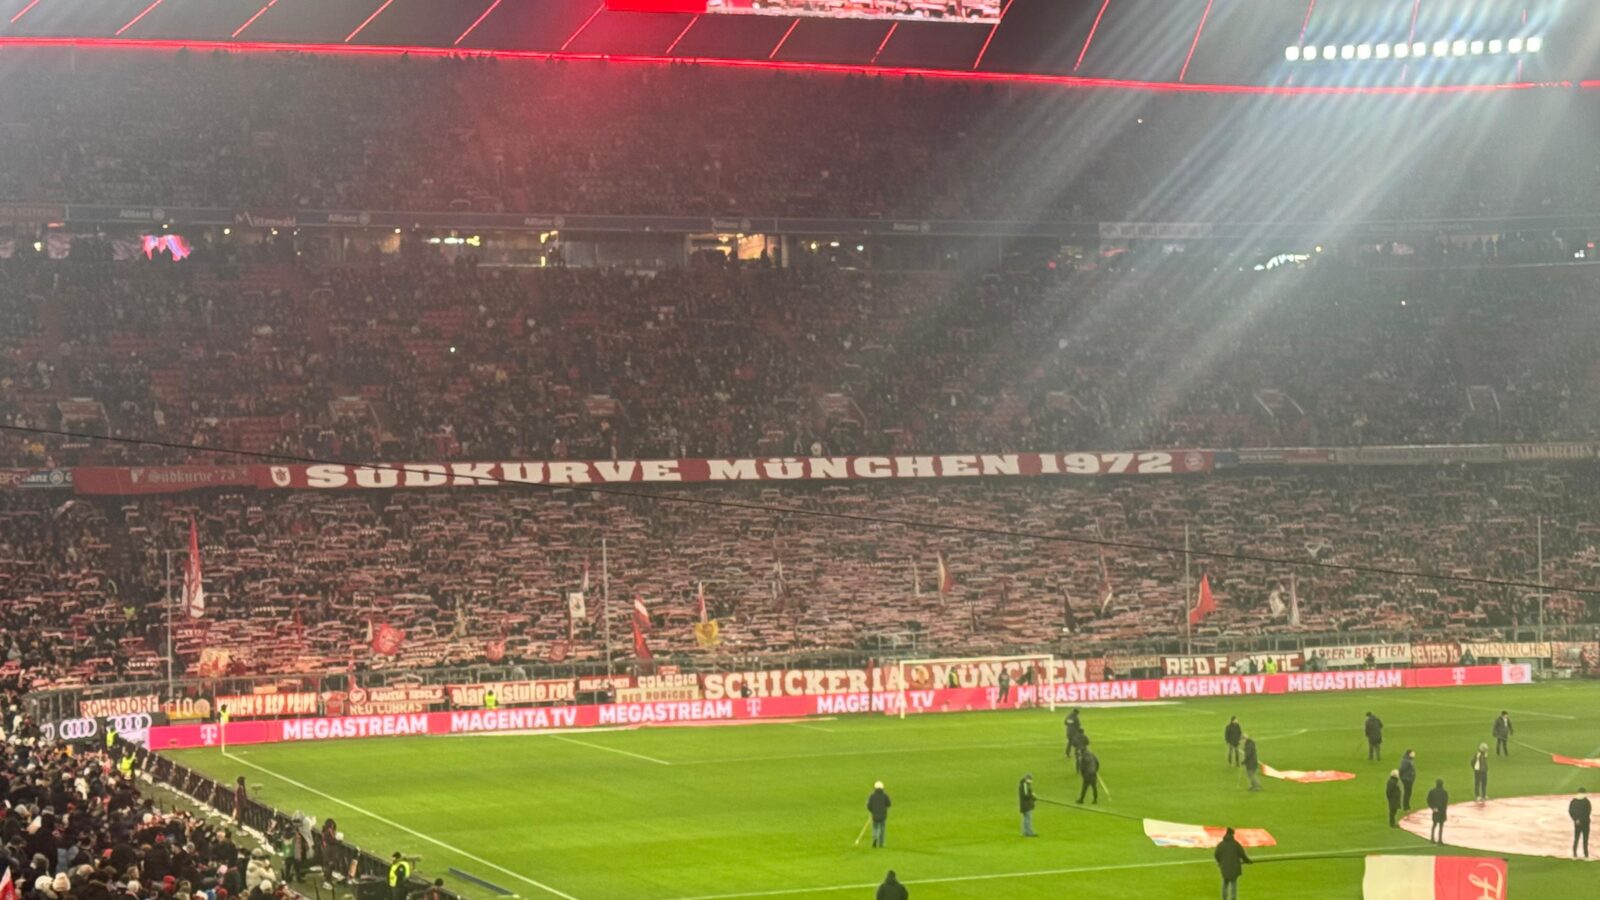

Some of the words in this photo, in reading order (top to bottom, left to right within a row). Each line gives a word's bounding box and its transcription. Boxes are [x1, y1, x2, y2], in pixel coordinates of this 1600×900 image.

[305, 459, 682, 489] SÜDKURVE
[708, 453, 1021, 481] MÜNCHEN
[1040, 452, 1173, 474] 1972
[1165, 656, 1211, 675] RED
[704, 664, 909, 699] SCHICKERIA
[1159, 677, 1242, 698] MAGENTA
[1242, 676, 1266, 693] TV
[1287, 670, 1402, 692] MEGASTREAM
[600, 700, 733, 724] MEGASTREAM
[817, 692, 908, 714] MAGENTA
[909, 690, 936, 708] TV
[282, 714, 429, 740] MEGASTREAM
[450, 708, 548, 732] MAGENTA
[550, 707, 578, 727] TV
